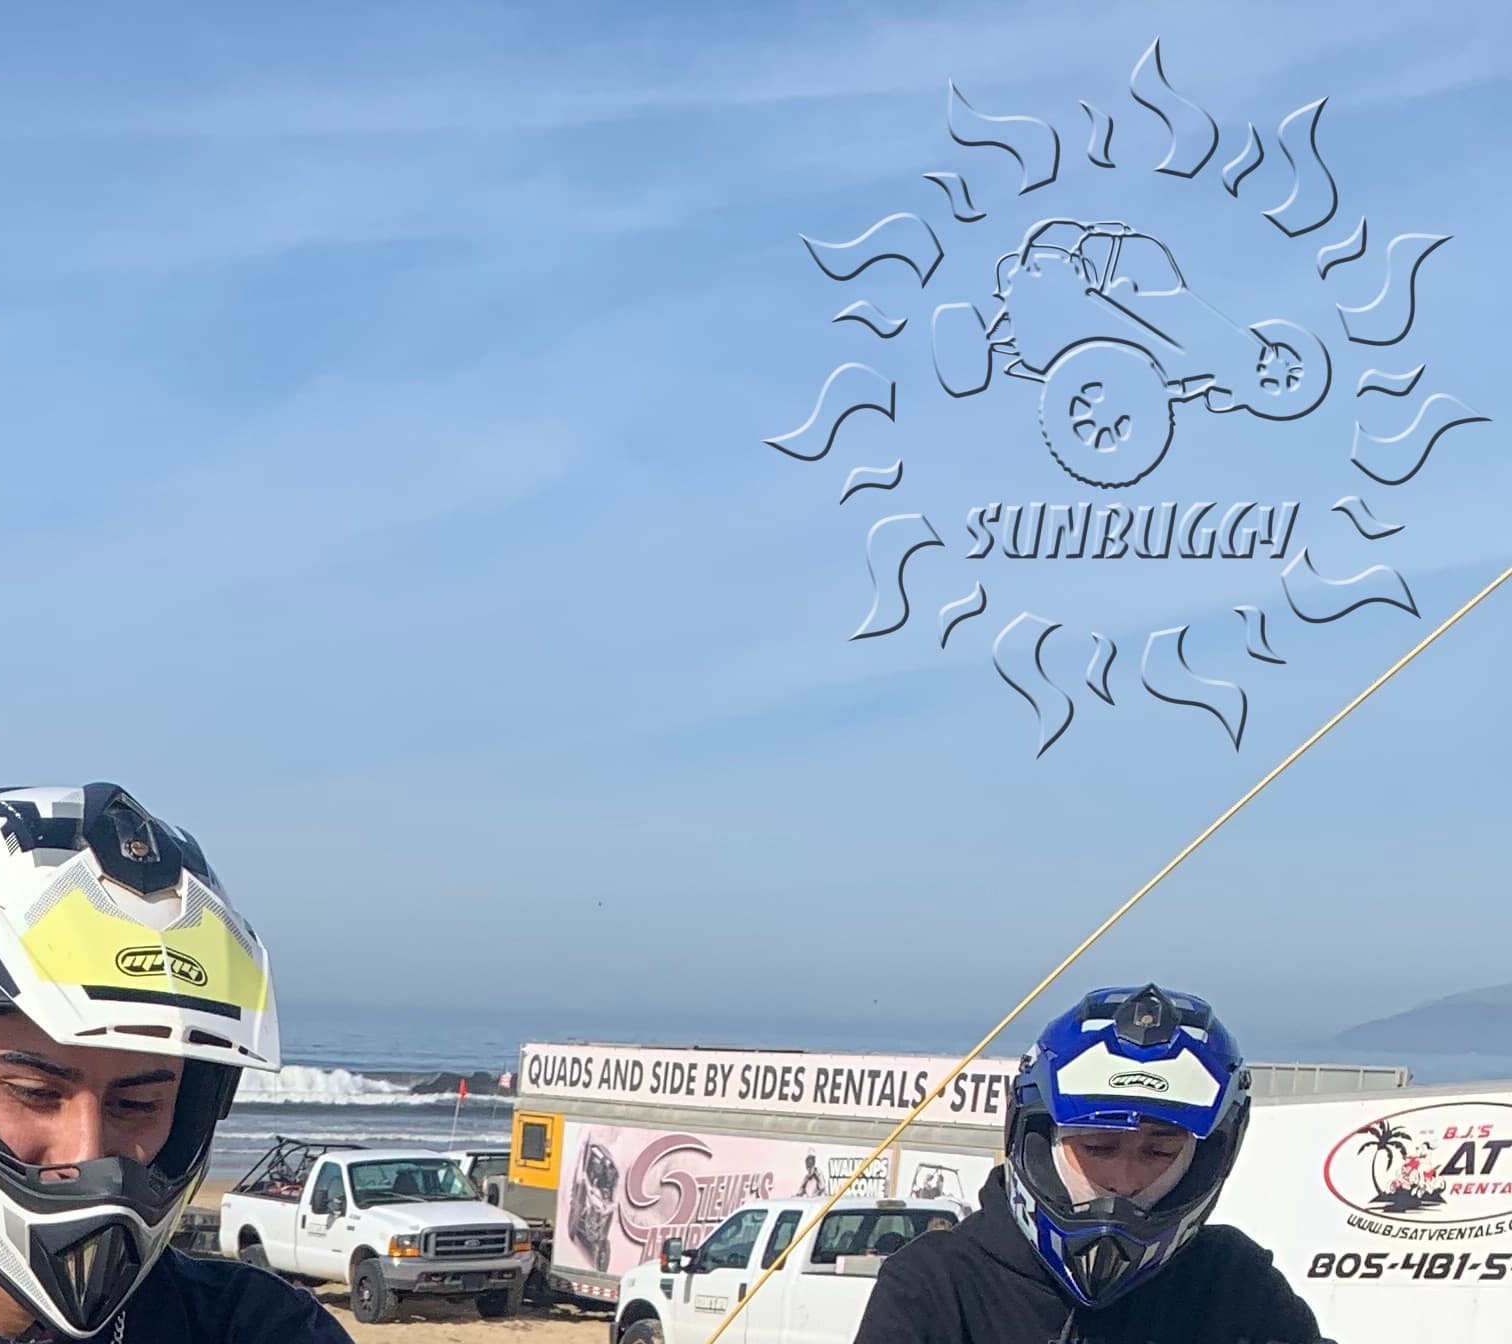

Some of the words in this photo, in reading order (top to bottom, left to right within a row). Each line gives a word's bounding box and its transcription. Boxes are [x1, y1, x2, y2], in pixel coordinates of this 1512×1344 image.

[528, 1054, 594, 1089] QUADS
[598, 1058, 644, 1092] AND
[649, 1060, 698, 1096] SIDE
[704, 1063, 734, 1098] BY
[738, 1063, 806, 1103] SIDES
[812, 1067, 928, 1110] RENTALS
[1307, 1252, 1512, 1281] 805-481-5
